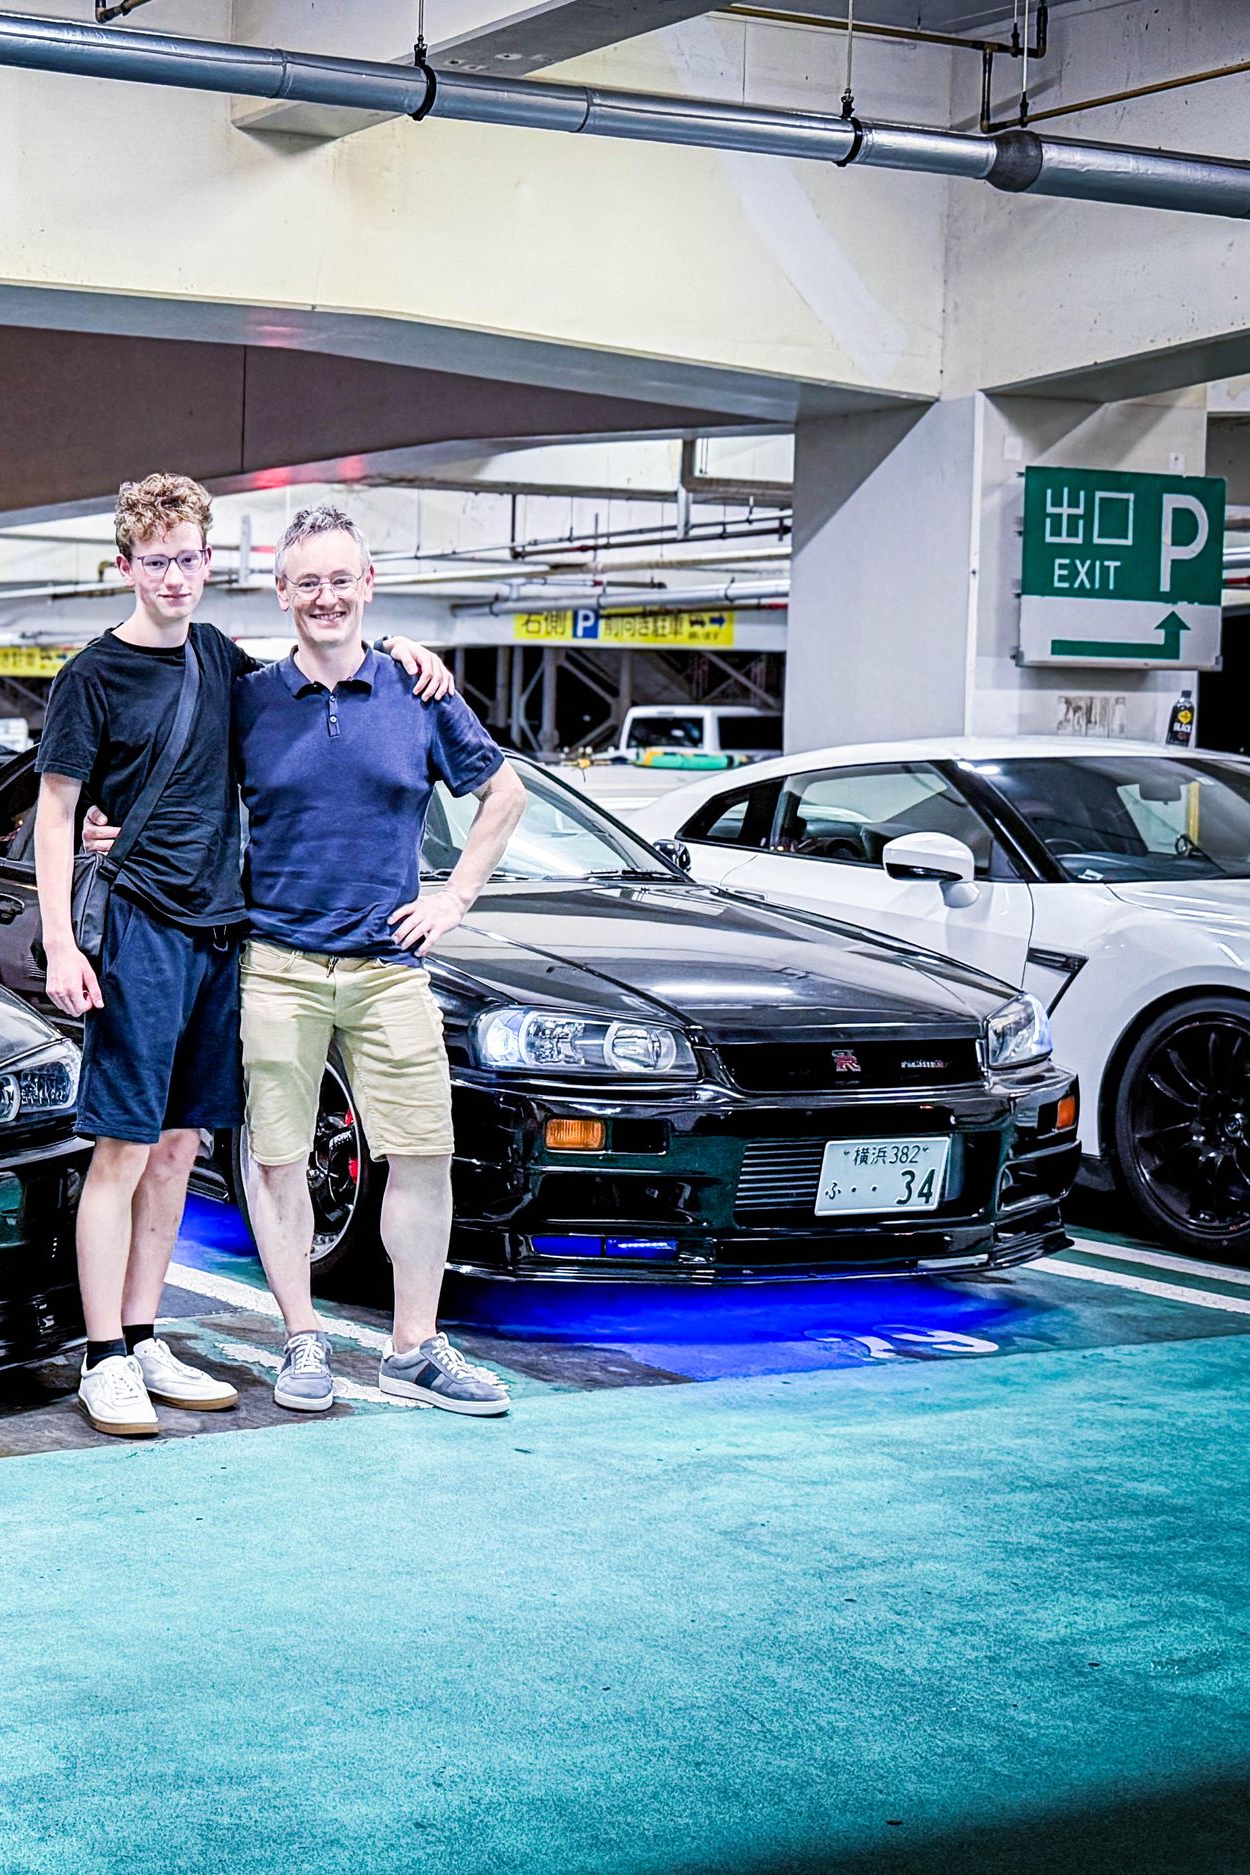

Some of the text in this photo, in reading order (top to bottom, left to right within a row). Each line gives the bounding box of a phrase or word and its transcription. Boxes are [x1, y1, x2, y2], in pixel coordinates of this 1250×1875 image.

[1045, 486, 1135, 546] 出口
[1160, 493, 1209, 592] P
[1053, 558, 1121, 590] EXIT
[576, 609, 596, 637] P
[853, 1145, 921, 1166] 横浜 382
[896, 1168, 936, 1205] 34
